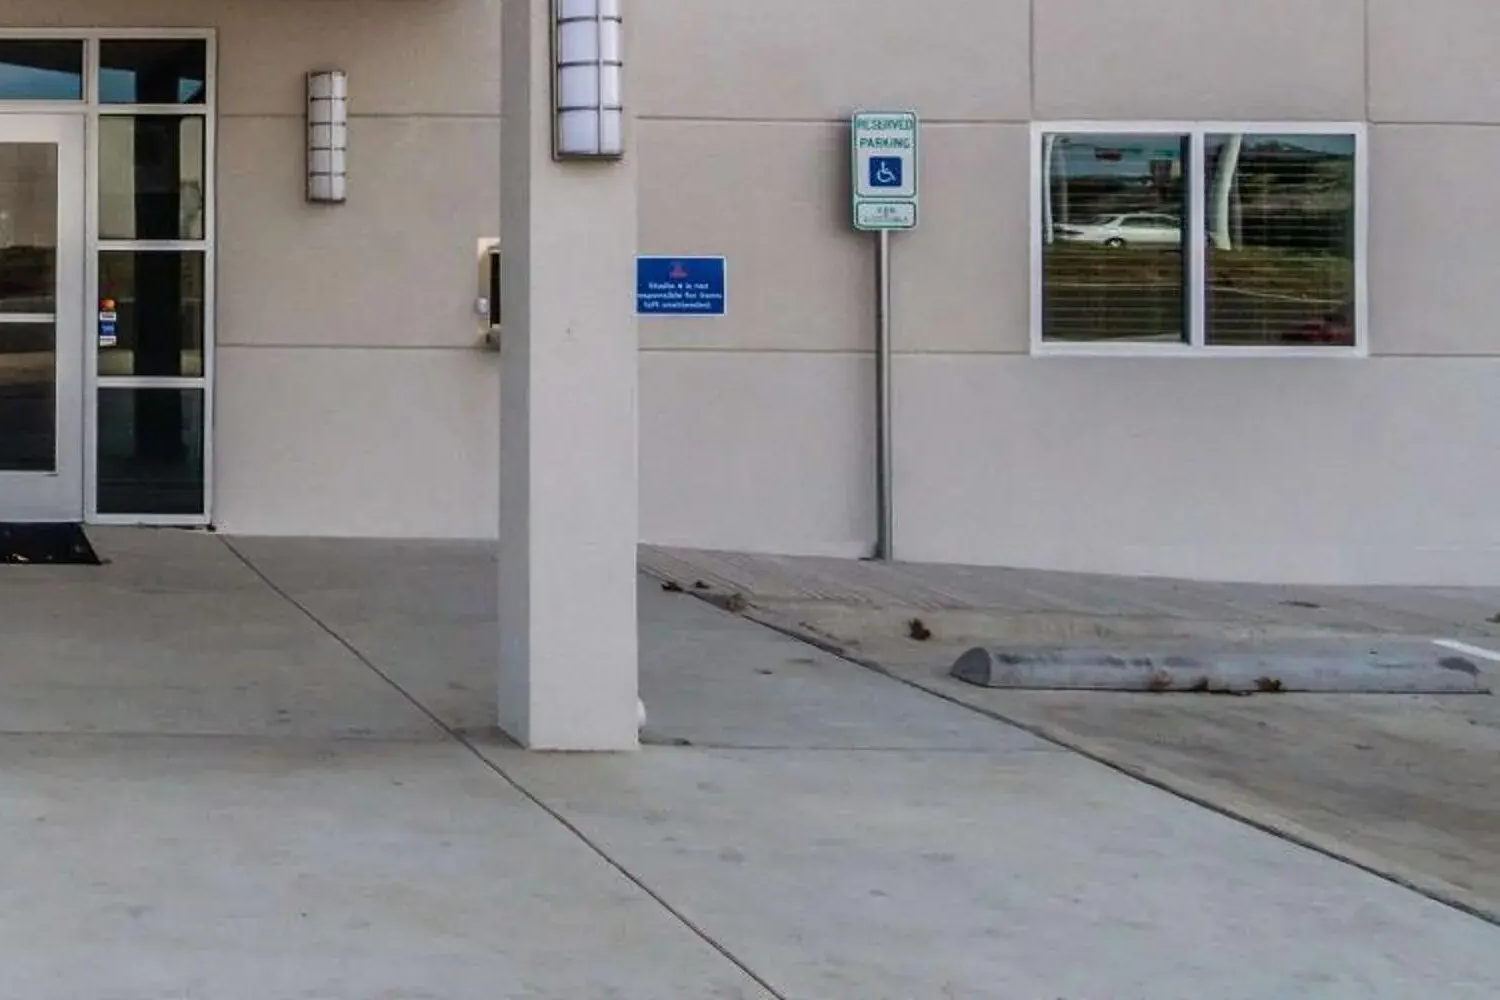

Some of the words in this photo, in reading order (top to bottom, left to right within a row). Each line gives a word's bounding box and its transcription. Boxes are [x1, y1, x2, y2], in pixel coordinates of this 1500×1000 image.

[855, 119, 913, 130] RESERVED
[860, 137, 910, 148] PARKING
[685, 290, 697, 299] for
[643, 300, 658, 309] left
